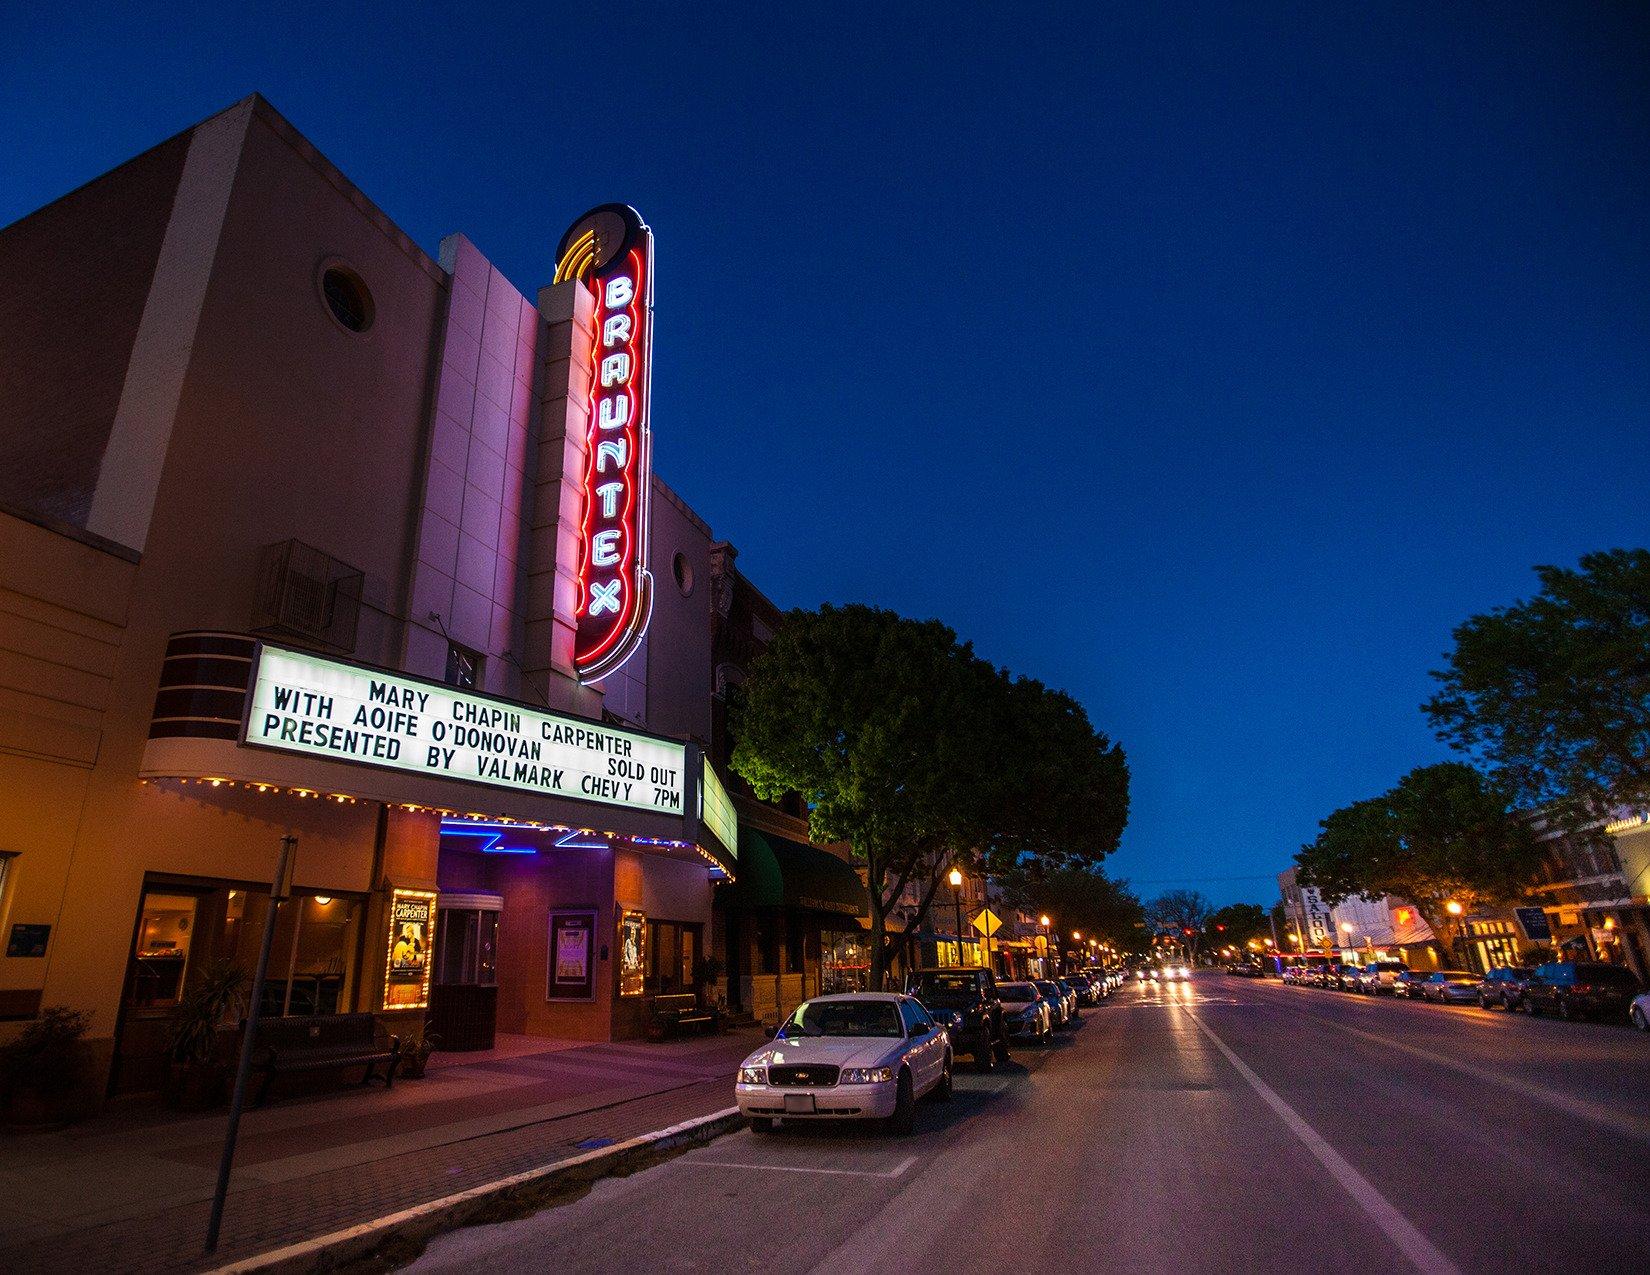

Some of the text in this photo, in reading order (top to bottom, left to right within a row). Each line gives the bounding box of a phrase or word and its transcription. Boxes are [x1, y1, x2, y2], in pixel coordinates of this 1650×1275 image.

[589, 276, 633, 616] BRAUNTEX
[262, 713, 681, 809] PRESENTED BY VALMARK CHEVY 7PM
[274, 686, 677, 788] WITH AOIFE O'DONOVAN SOLD OUT
[369, 680, 632, 757] MARY CHAPIN CARPENTER
